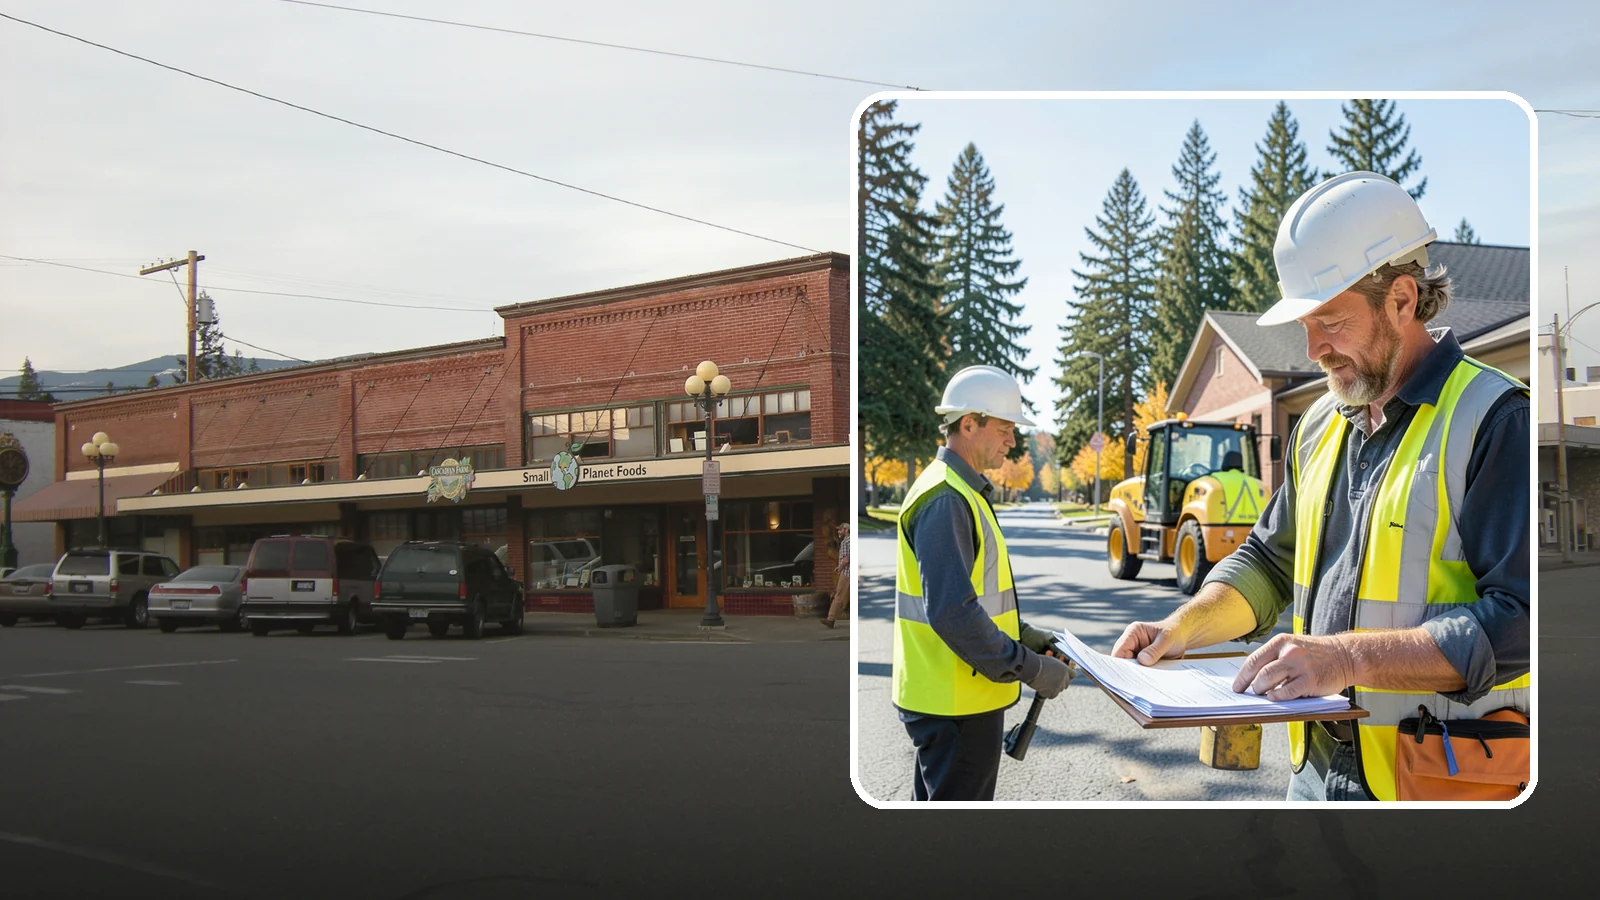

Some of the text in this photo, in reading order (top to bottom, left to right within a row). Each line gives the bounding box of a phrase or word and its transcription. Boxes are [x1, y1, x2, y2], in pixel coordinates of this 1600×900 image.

[523, 464, 647, 483] Small Planet Foods
